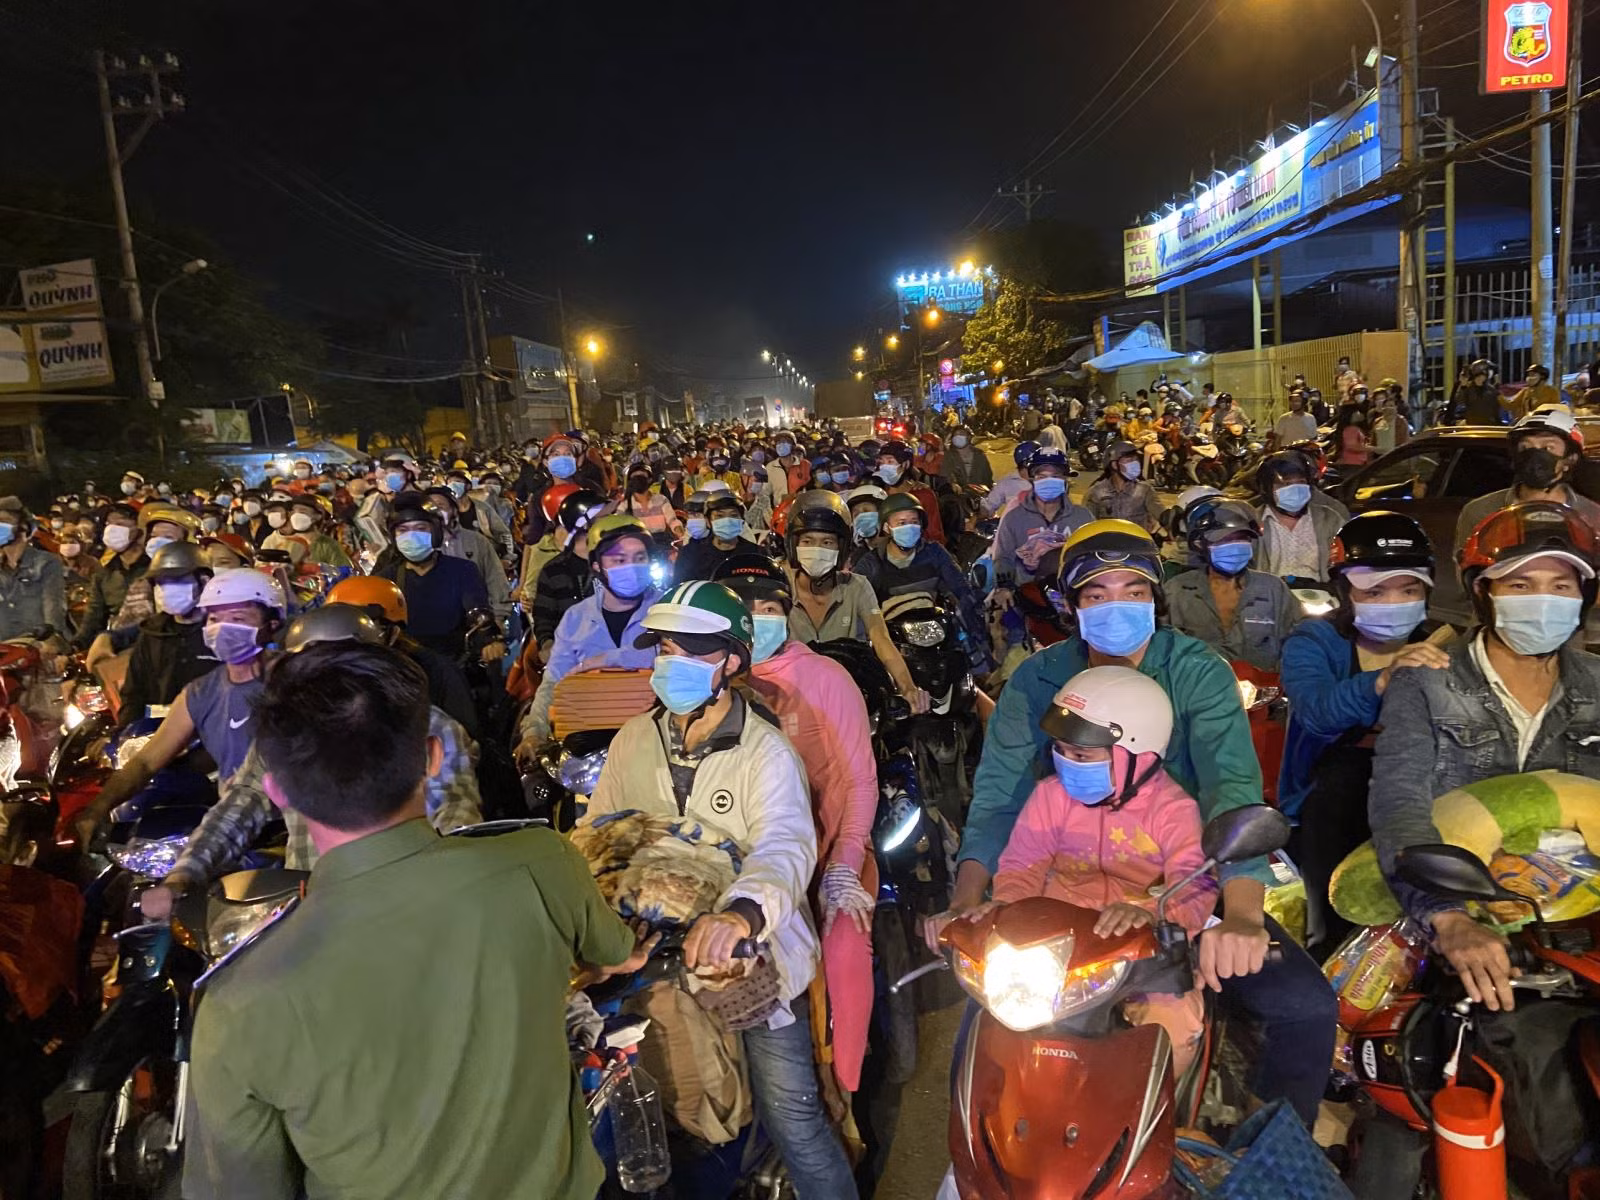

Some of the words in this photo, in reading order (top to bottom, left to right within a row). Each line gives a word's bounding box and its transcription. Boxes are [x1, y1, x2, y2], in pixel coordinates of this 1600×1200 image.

[1500, 73, 1553, 86] PETRO
[732, 567, 769, 576] HONDA
[1032, 1046, 1078, 1060] HONDA
